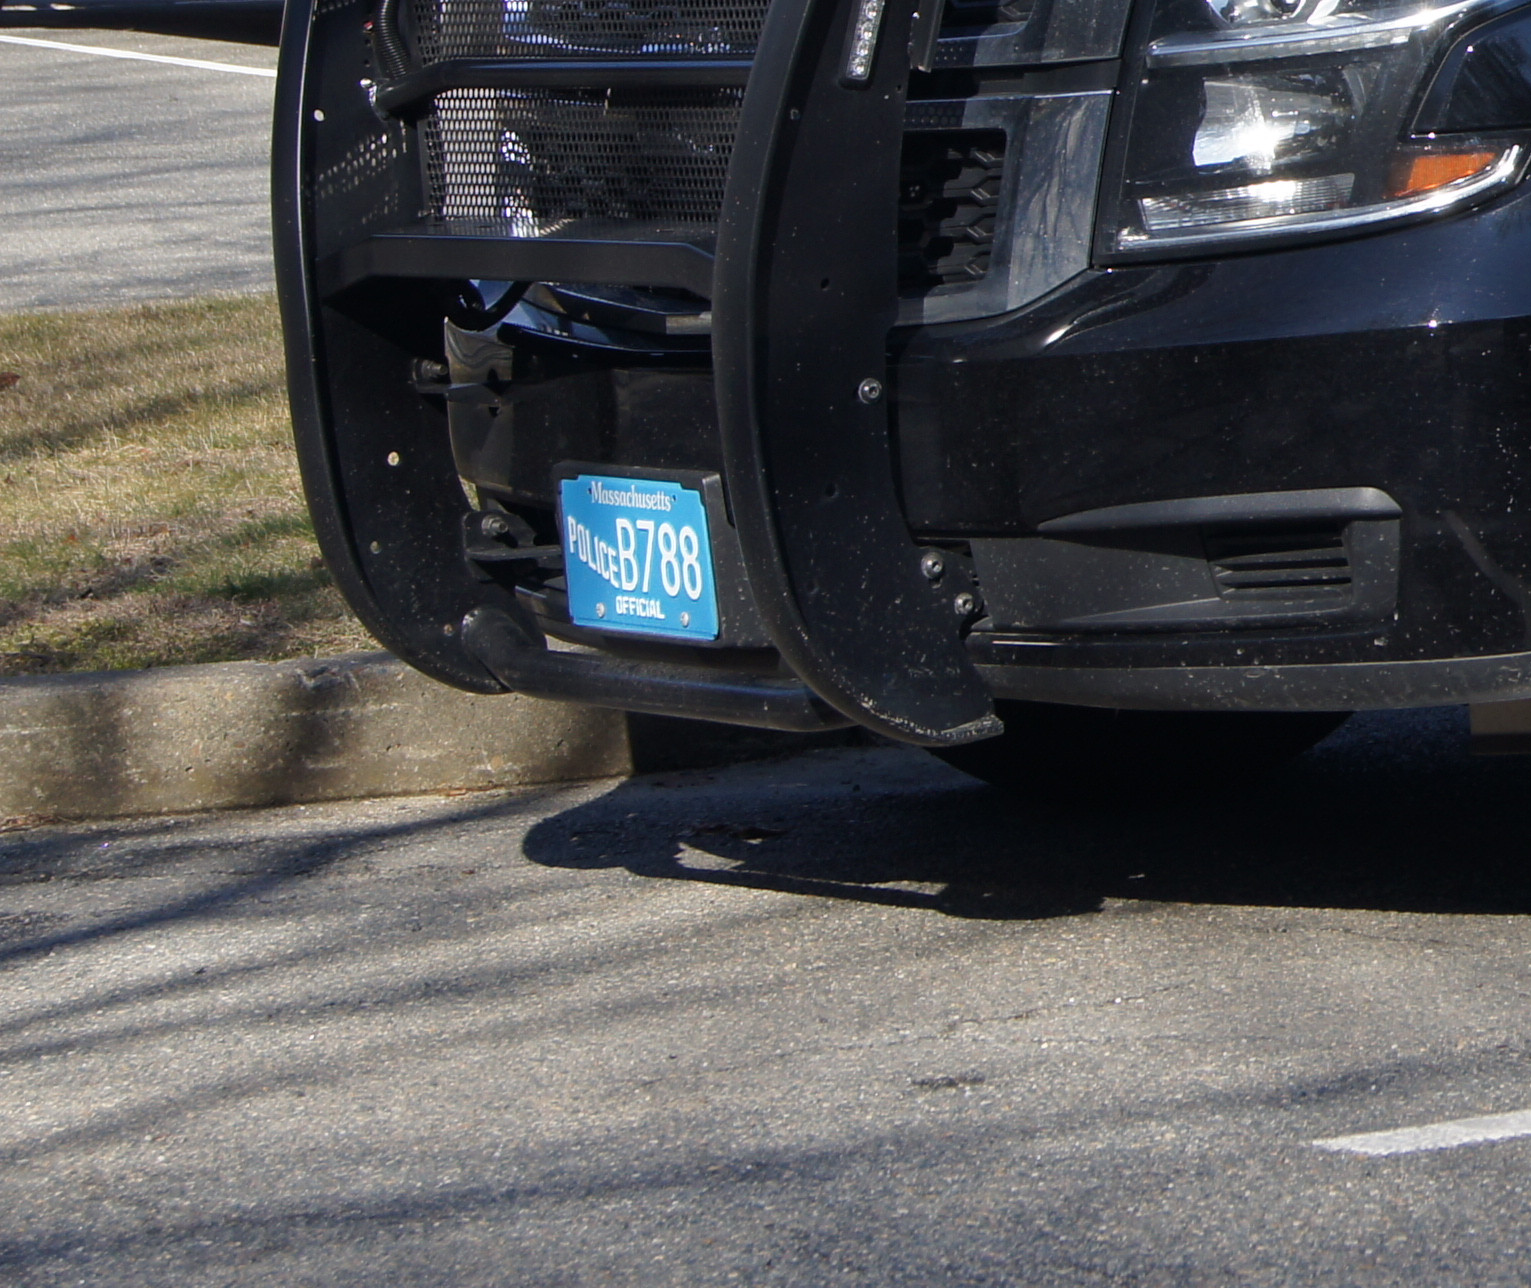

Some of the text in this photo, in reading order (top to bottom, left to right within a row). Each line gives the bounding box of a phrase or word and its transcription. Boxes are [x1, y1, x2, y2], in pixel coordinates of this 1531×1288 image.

[590, 480, 672, 512] Massachusetts
[567, 515, 703, 601] POLICE B788
[615, 595, 666, 620] OFFICIAL
